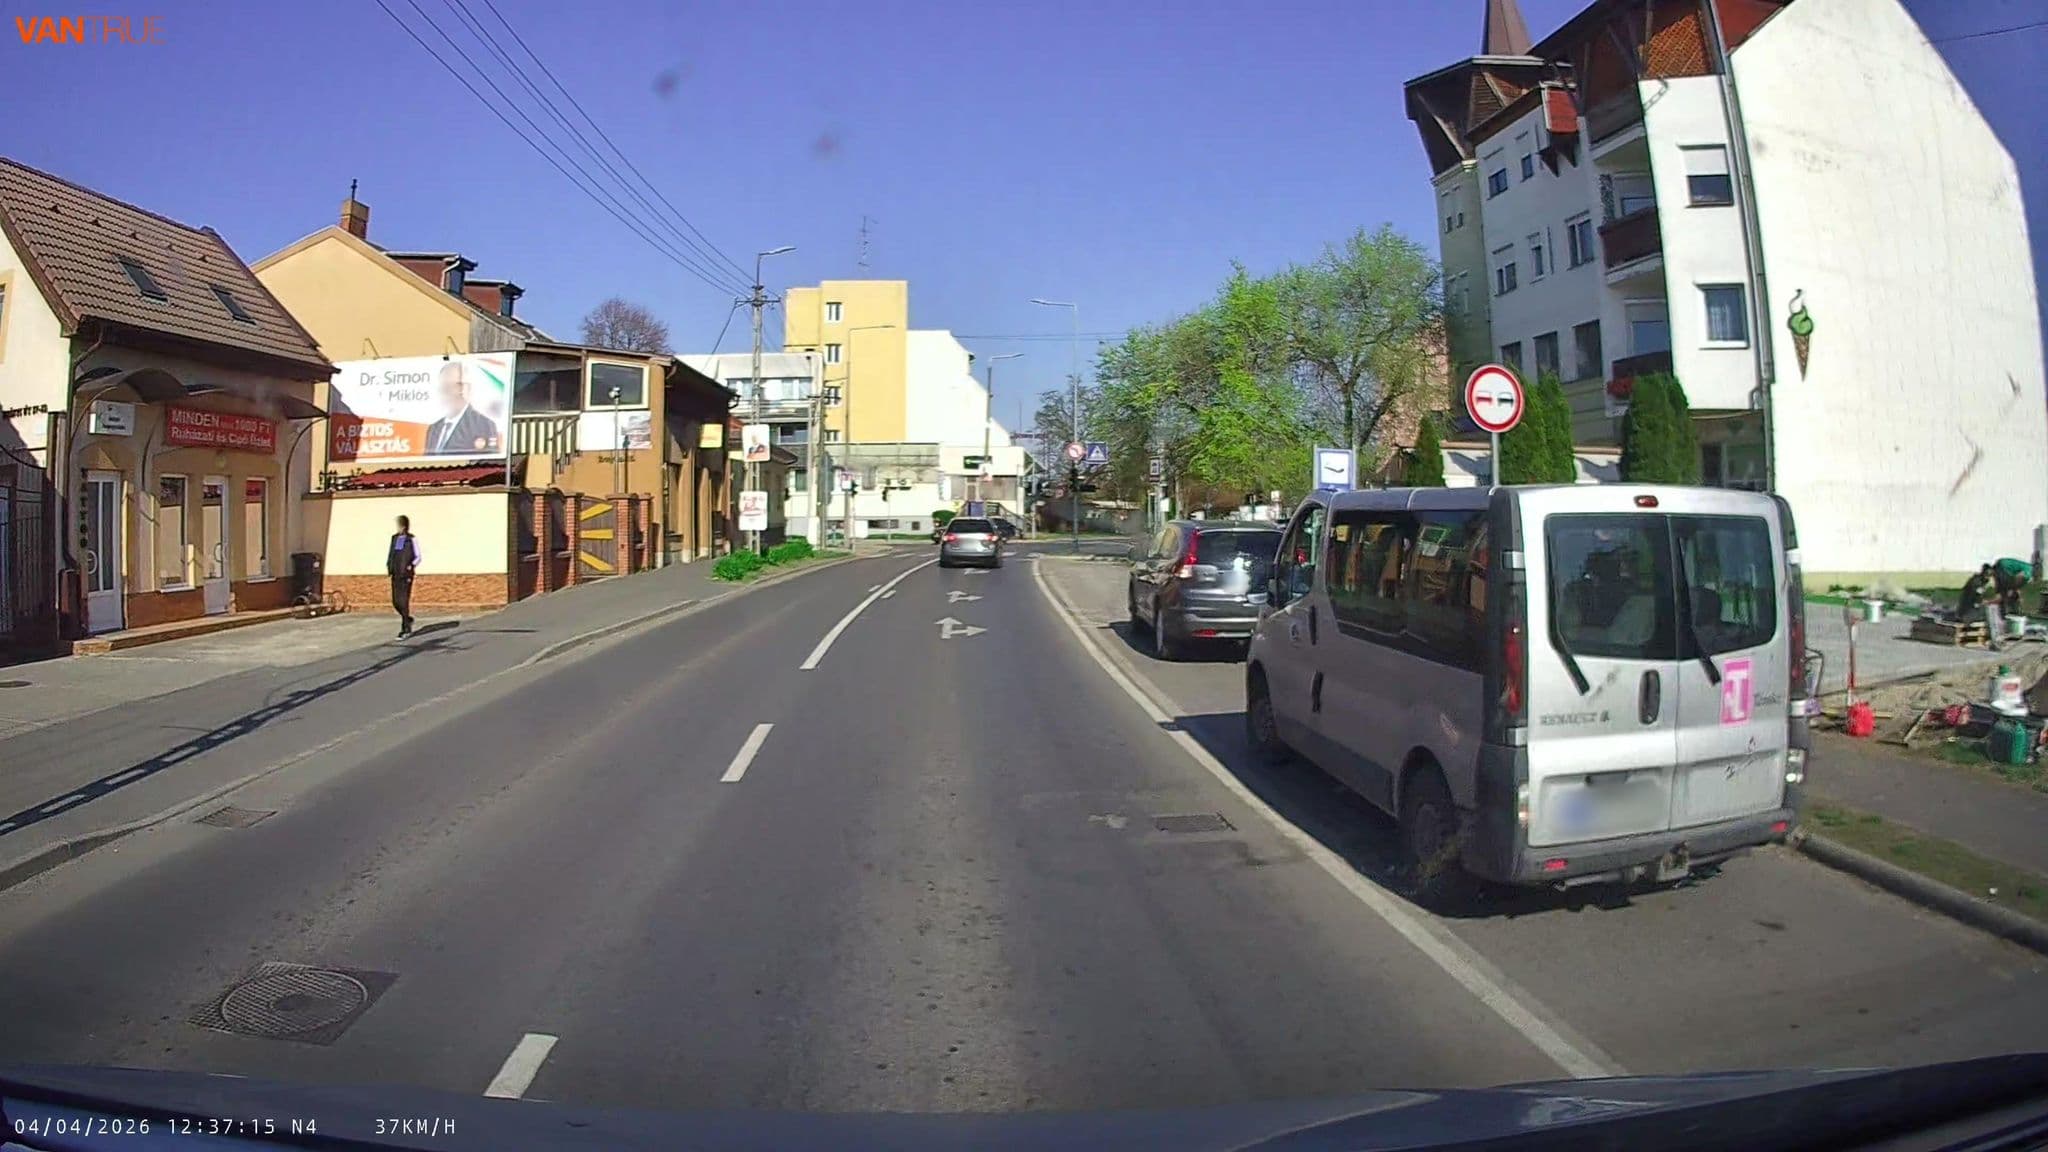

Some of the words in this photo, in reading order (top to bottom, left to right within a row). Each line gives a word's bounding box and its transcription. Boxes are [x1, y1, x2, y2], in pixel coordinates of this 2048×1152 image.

[360, 372, 380, 386] Dr.
[384, 371, 430, 385] Simon
[171, 409, 220, 427] MINDEN
[336, 425, 346, 438] A
[348, 422, 394, 438] BIZTOS
